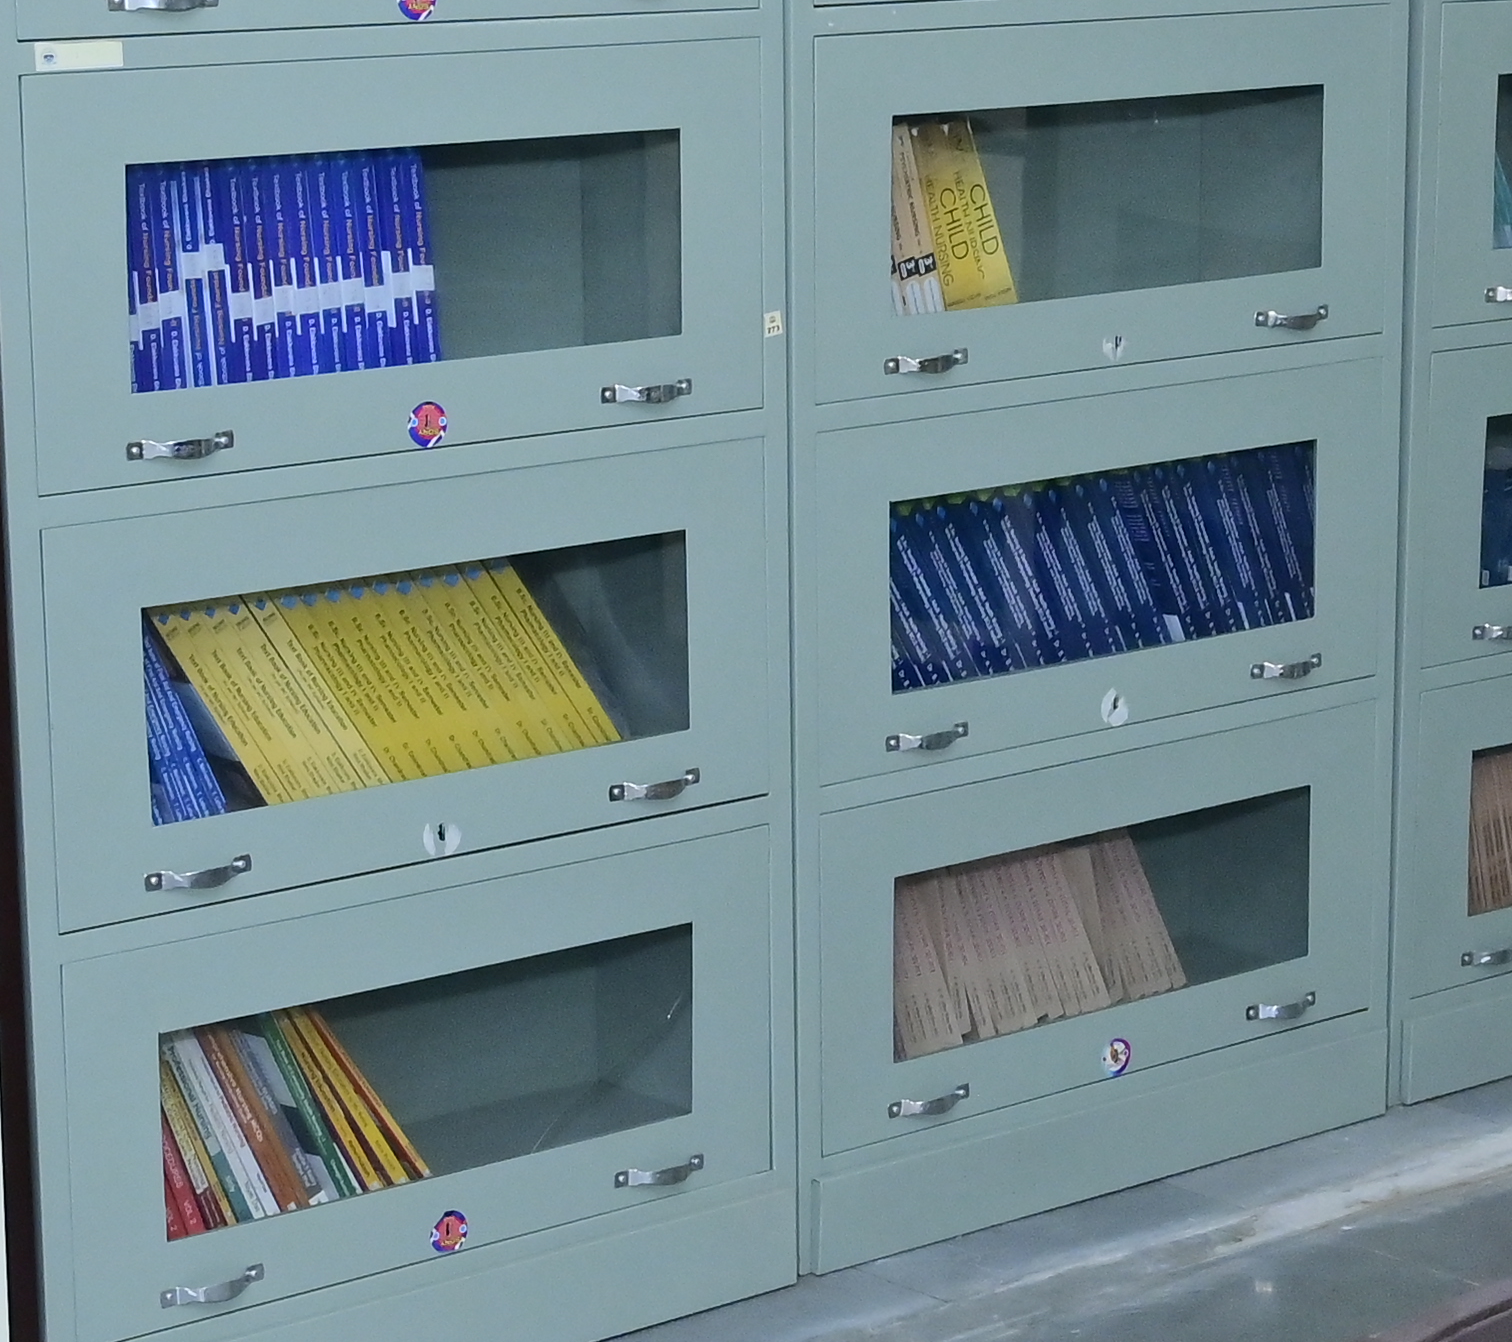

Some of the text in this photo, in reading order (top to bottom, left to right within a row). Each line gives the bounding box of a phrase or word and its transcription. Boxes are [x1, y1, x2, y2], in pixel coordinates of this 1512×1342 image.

[939, 188, 968, 259] CHILD
[969, 184, 999, 255] CHILD
[934, 226, 954, 286] NURSING
